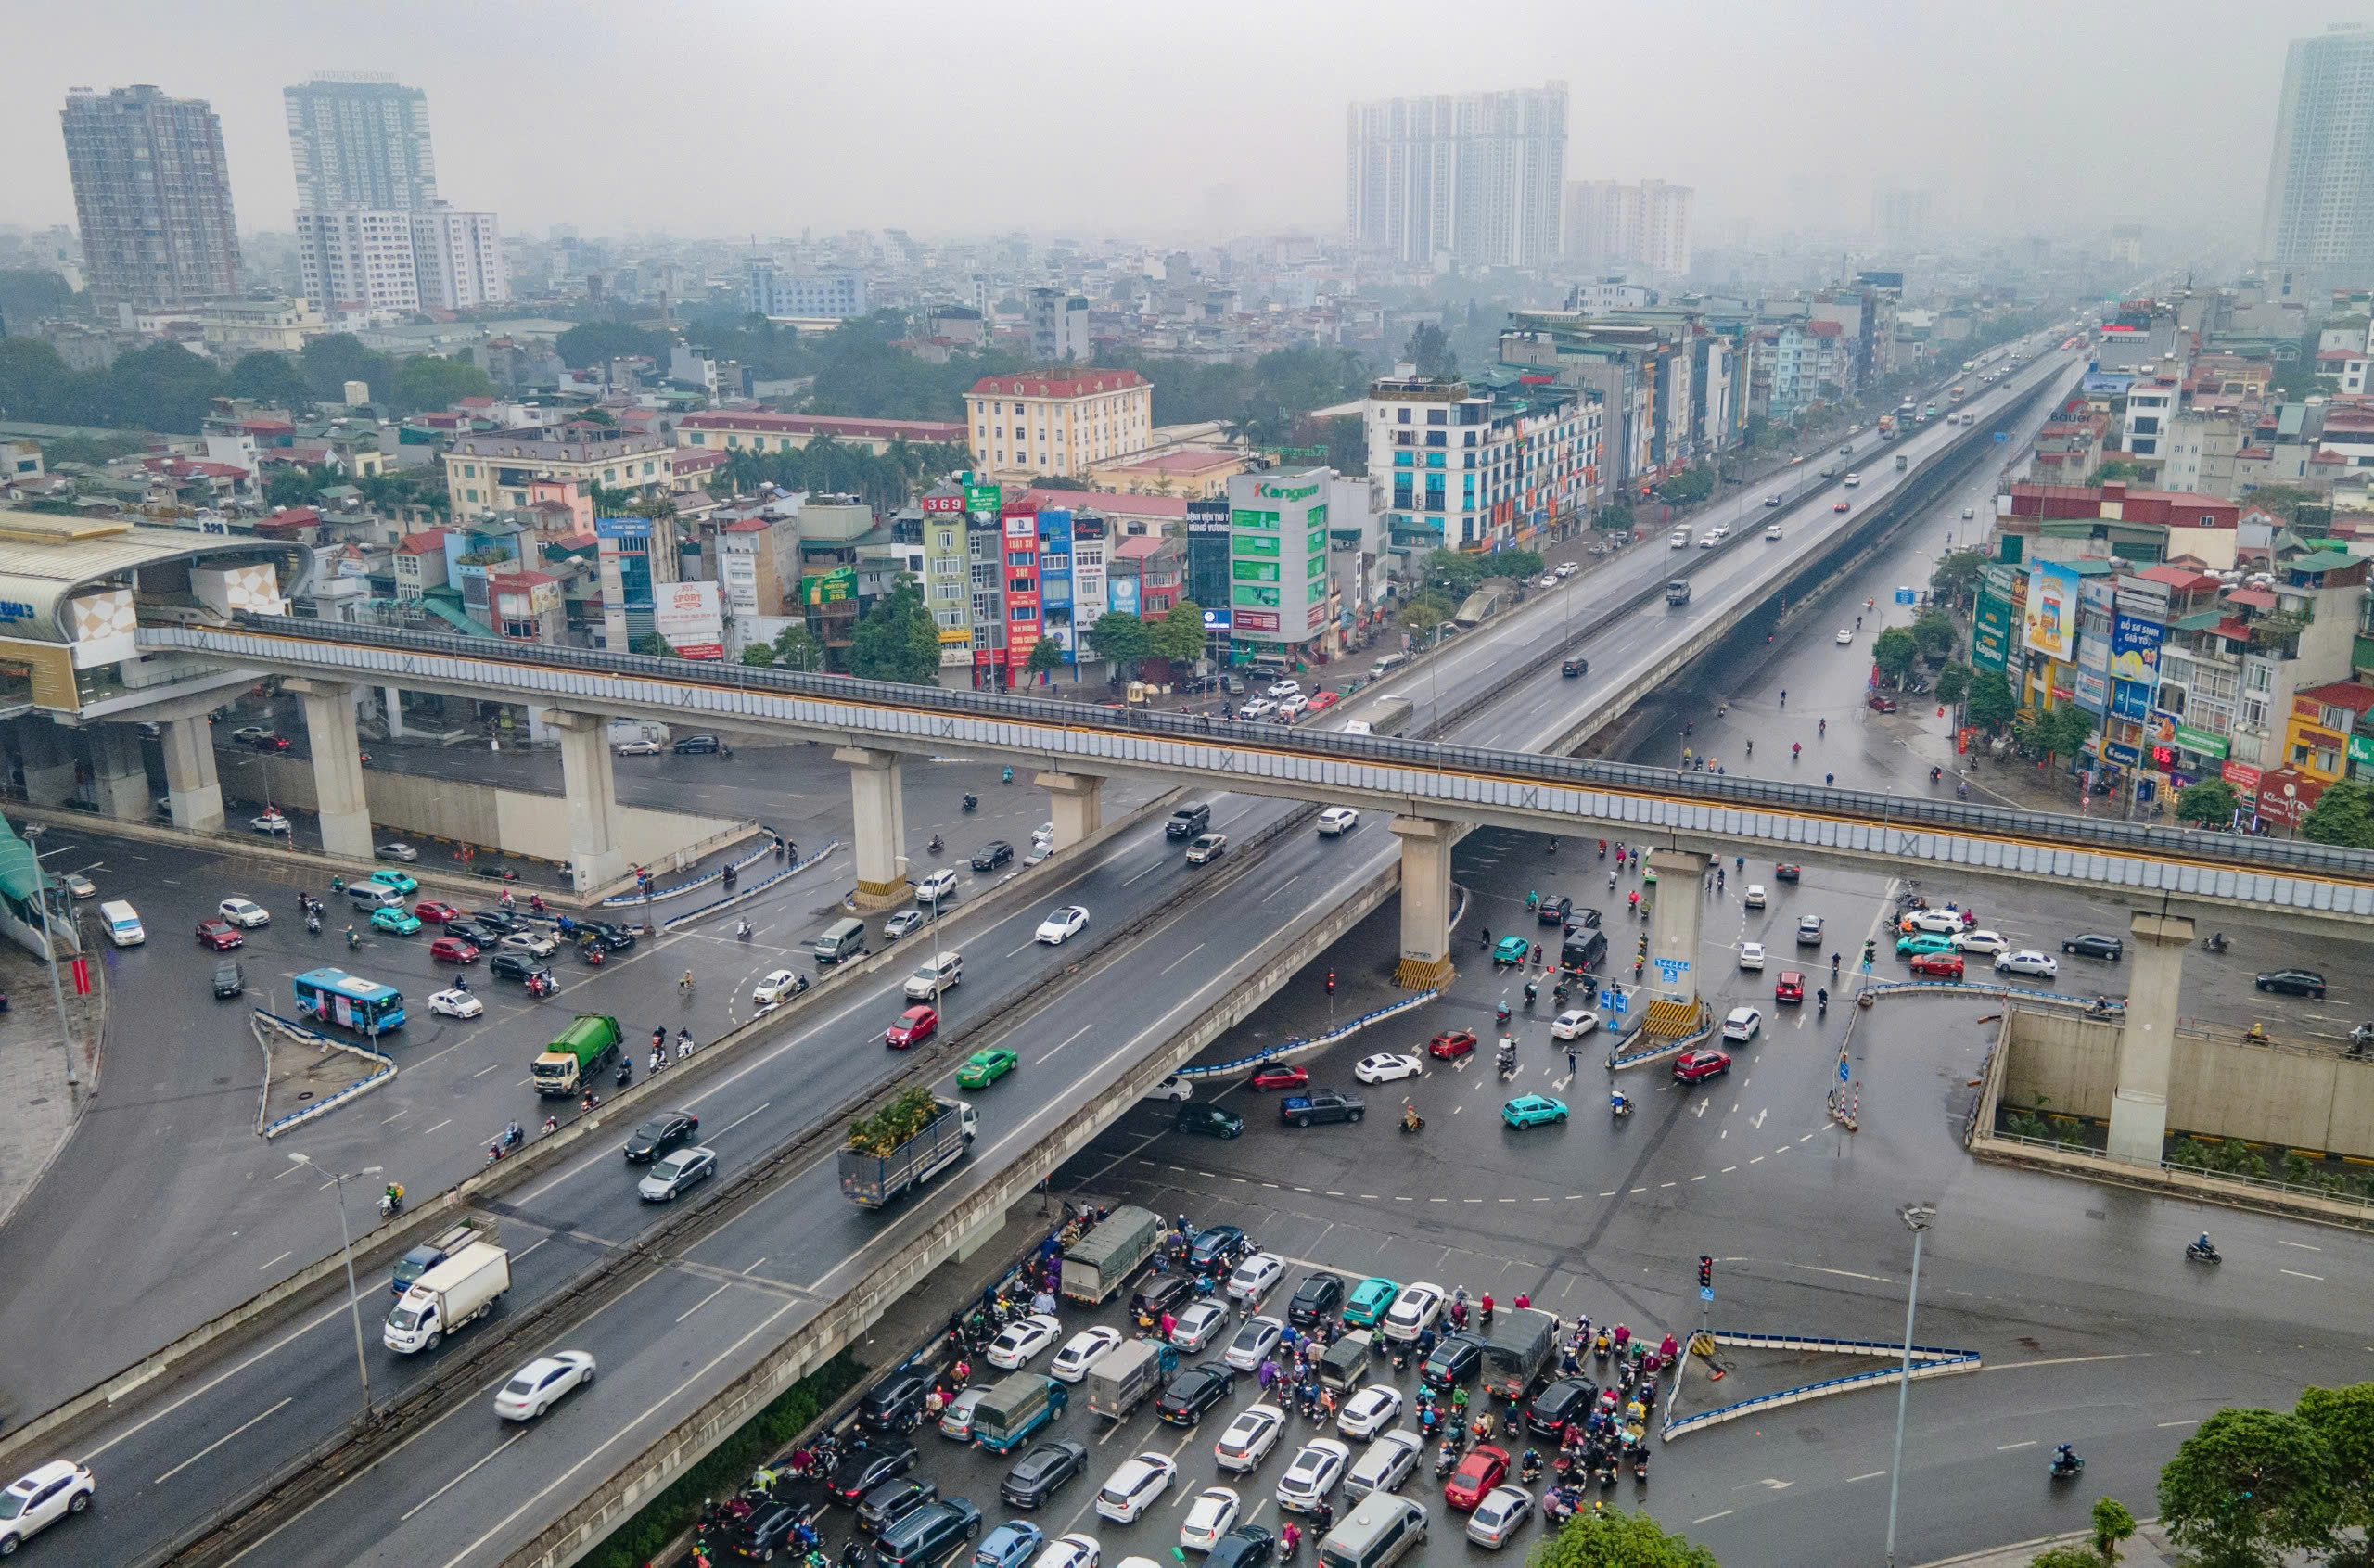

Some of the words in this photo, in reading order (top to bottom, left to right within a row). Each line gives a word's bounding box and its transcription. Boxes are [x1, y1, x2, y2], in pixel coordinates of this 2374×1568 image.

[2050, 411, 2093, 423] Bauer
[928, 499, 962, 510] 369
[673, 593, 703, 603] SPORT
[2141, 626, 2160, 638] SINH
